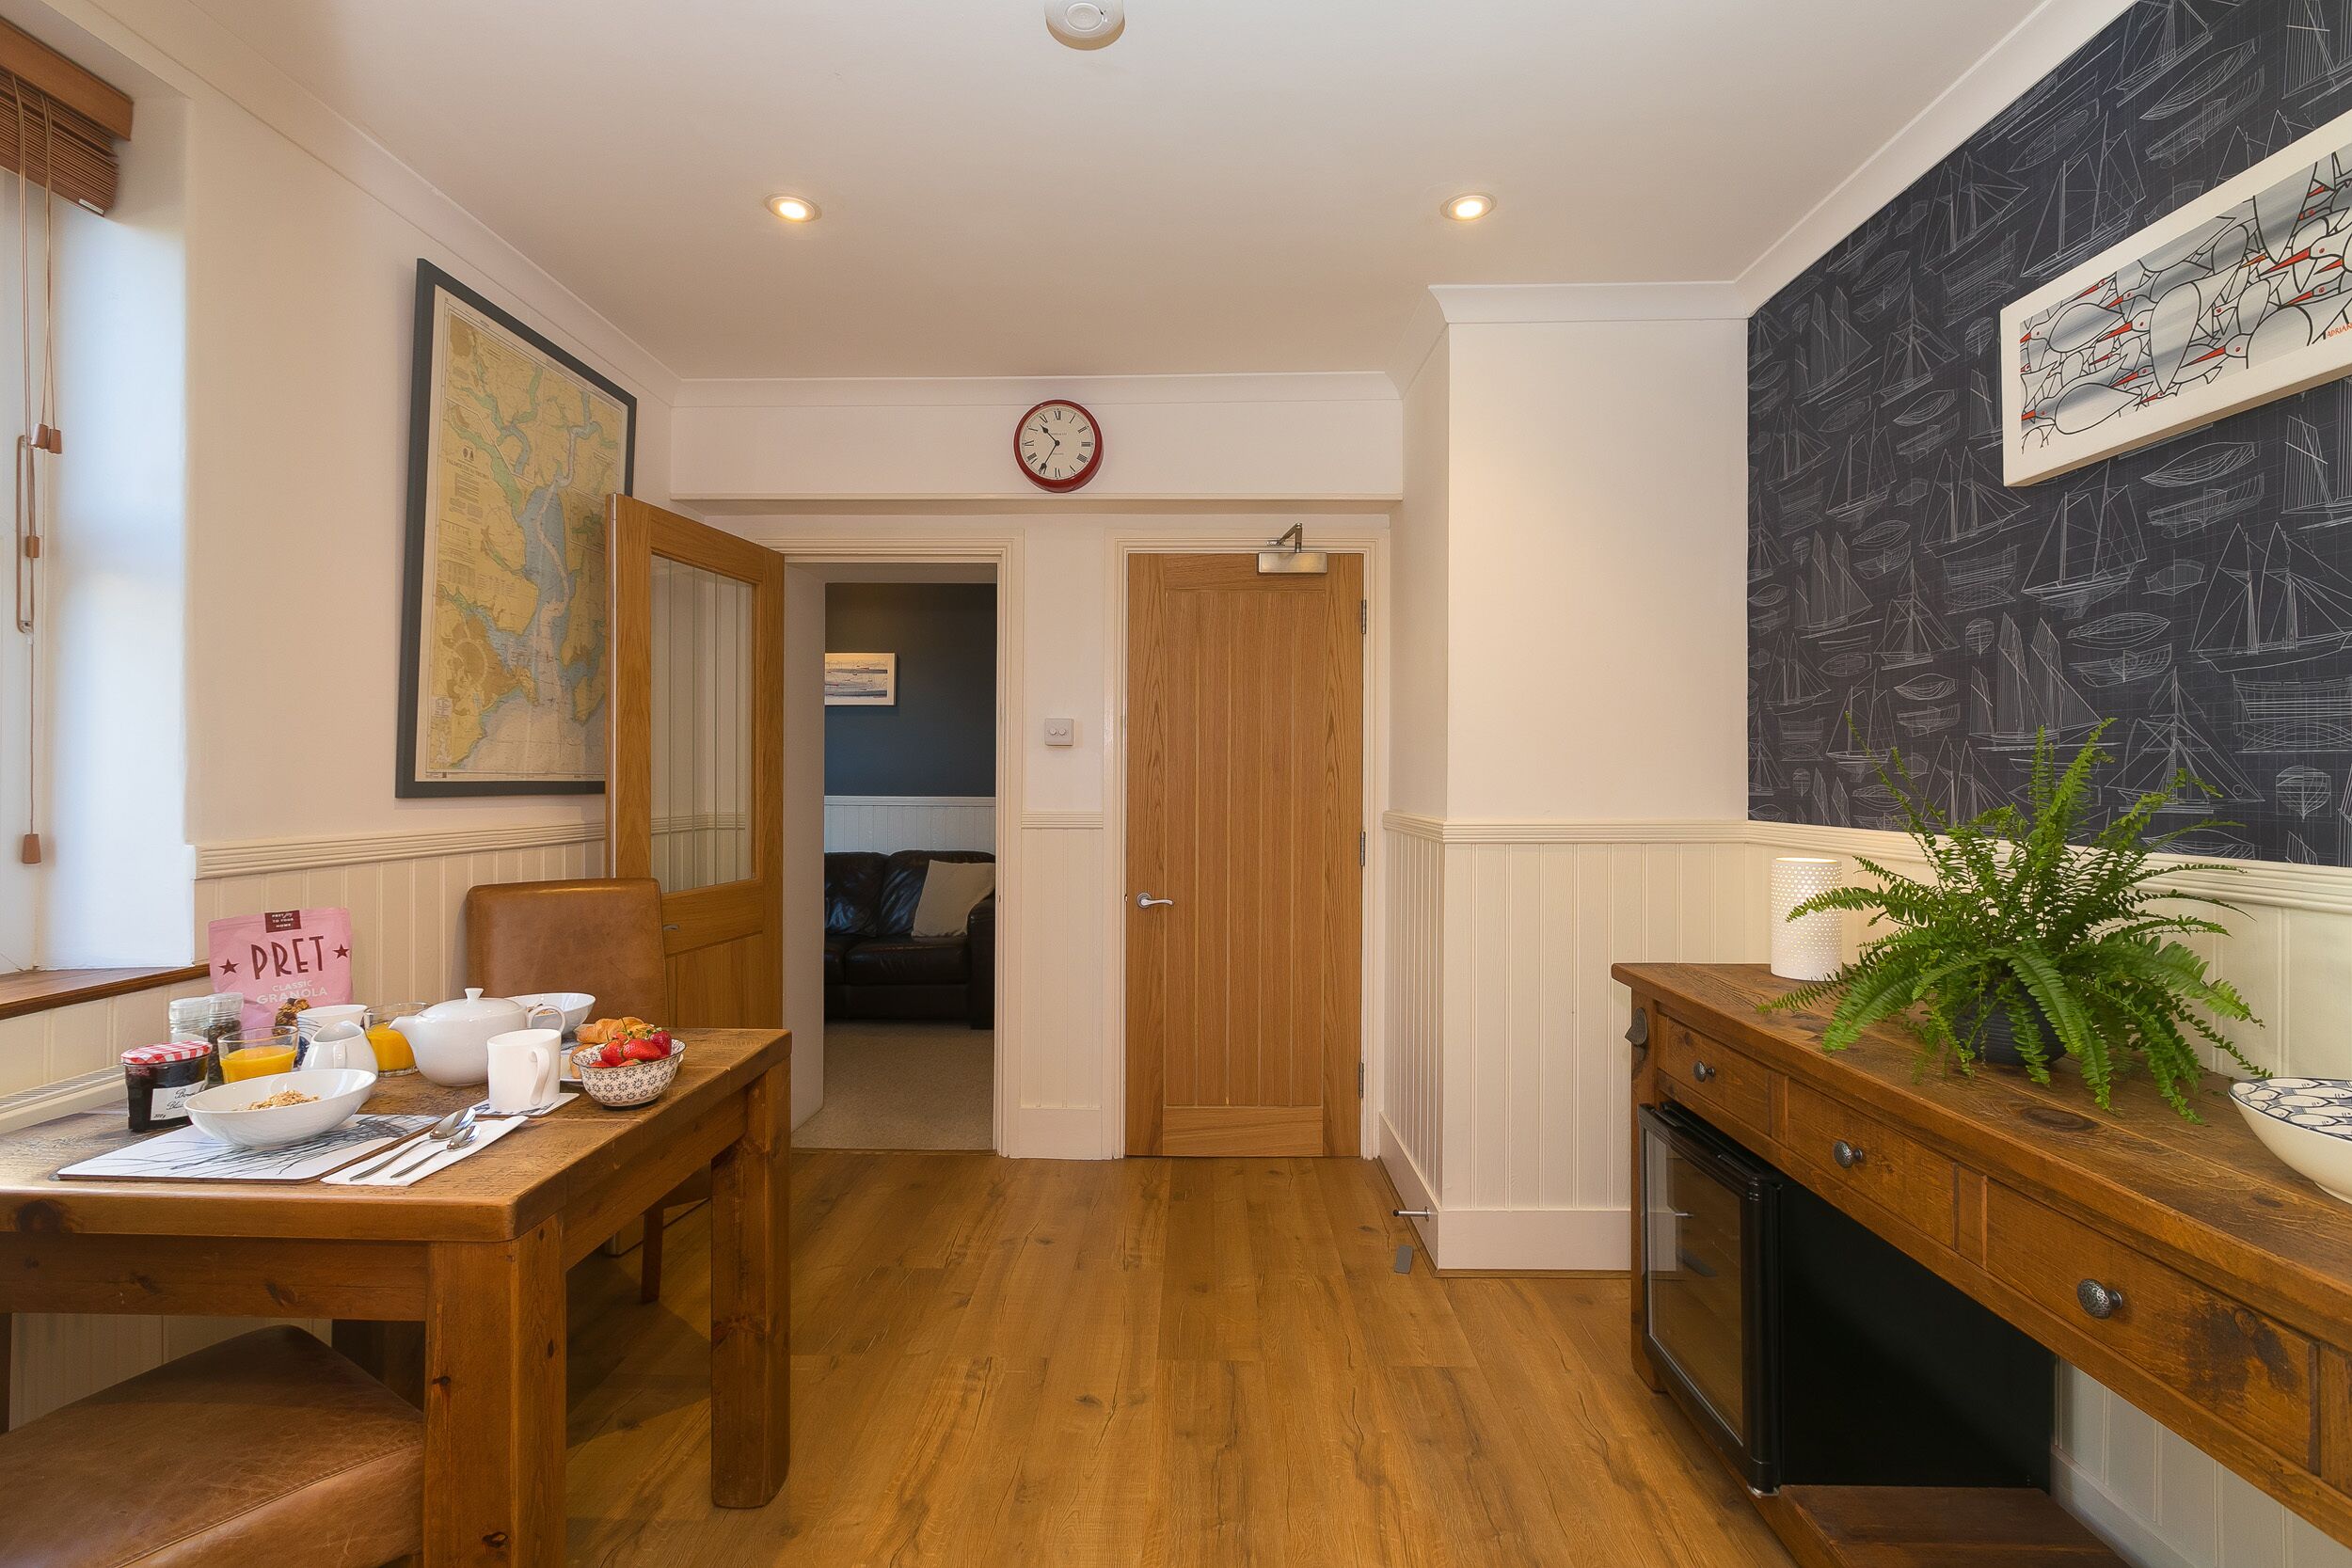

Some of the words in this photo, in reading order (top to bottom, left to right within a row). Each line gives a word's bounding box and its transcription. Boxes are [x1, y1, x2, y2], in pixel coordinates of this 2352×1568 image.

[251, 935, 324, 980] PRET
[272, 979, 312, 992] CLASSIC
[257, 987, 327, 1004] GRANOLA
